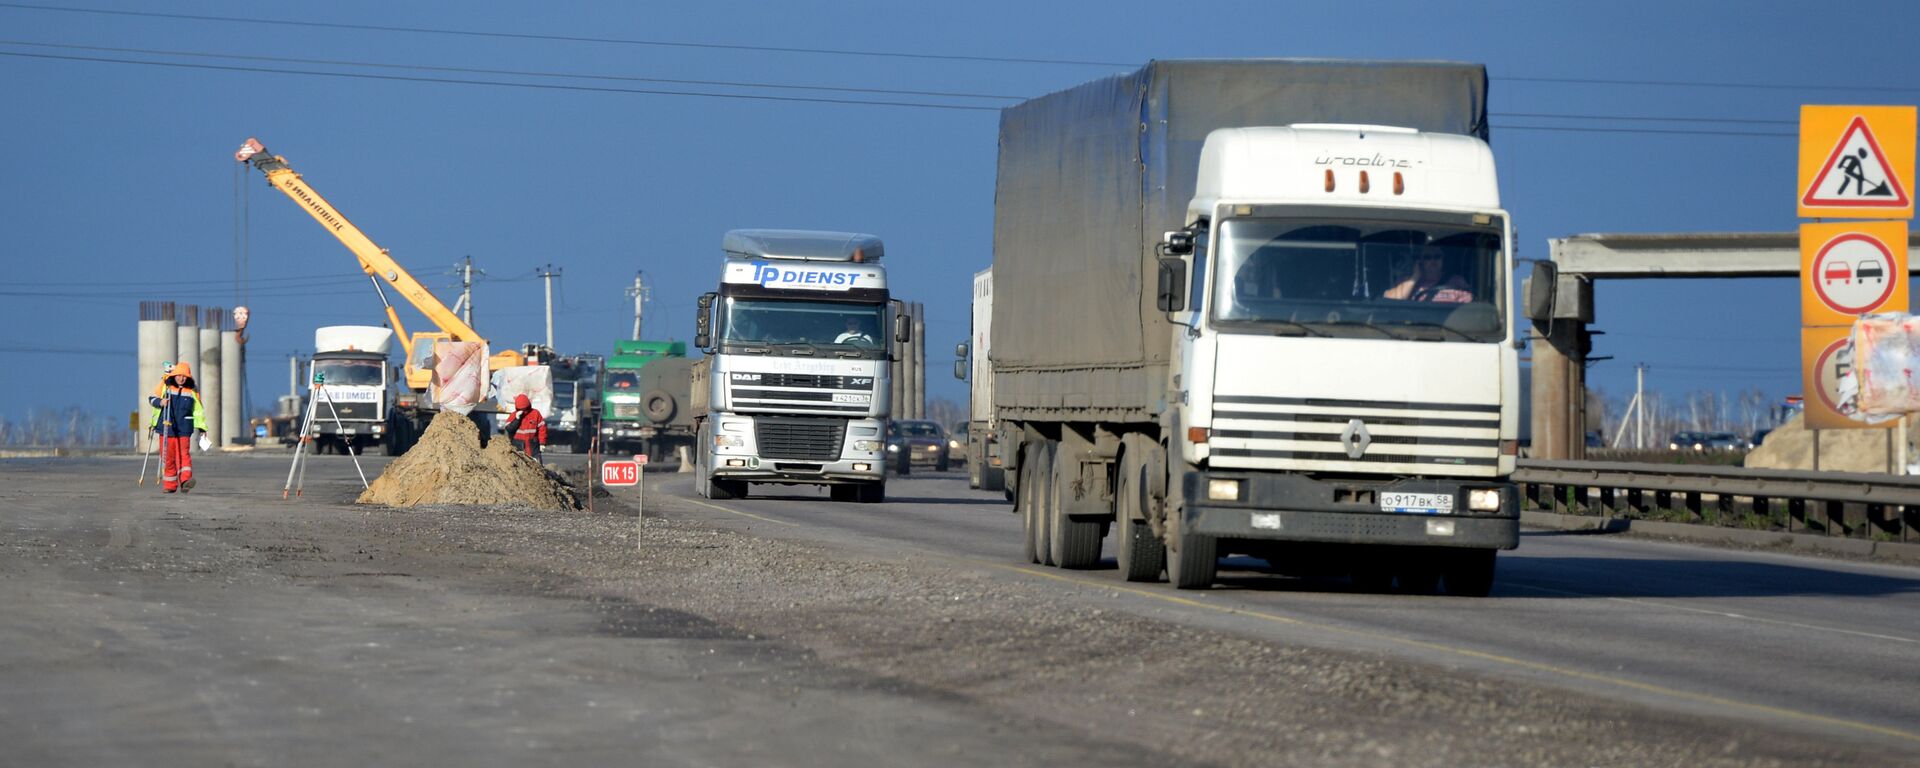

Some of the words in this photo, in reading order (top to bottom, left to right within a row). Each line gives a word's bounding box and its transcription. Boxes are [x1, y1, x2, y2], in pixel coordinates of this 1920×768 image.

[292, 186, 343, 232] ИВАНОВЕЦ
[782, 271, 861, 285] DIENST
[732, 373, 762, 381] DAF
[605, 466, 619, 480] ПК
[622, 466, 634, 480] 15
